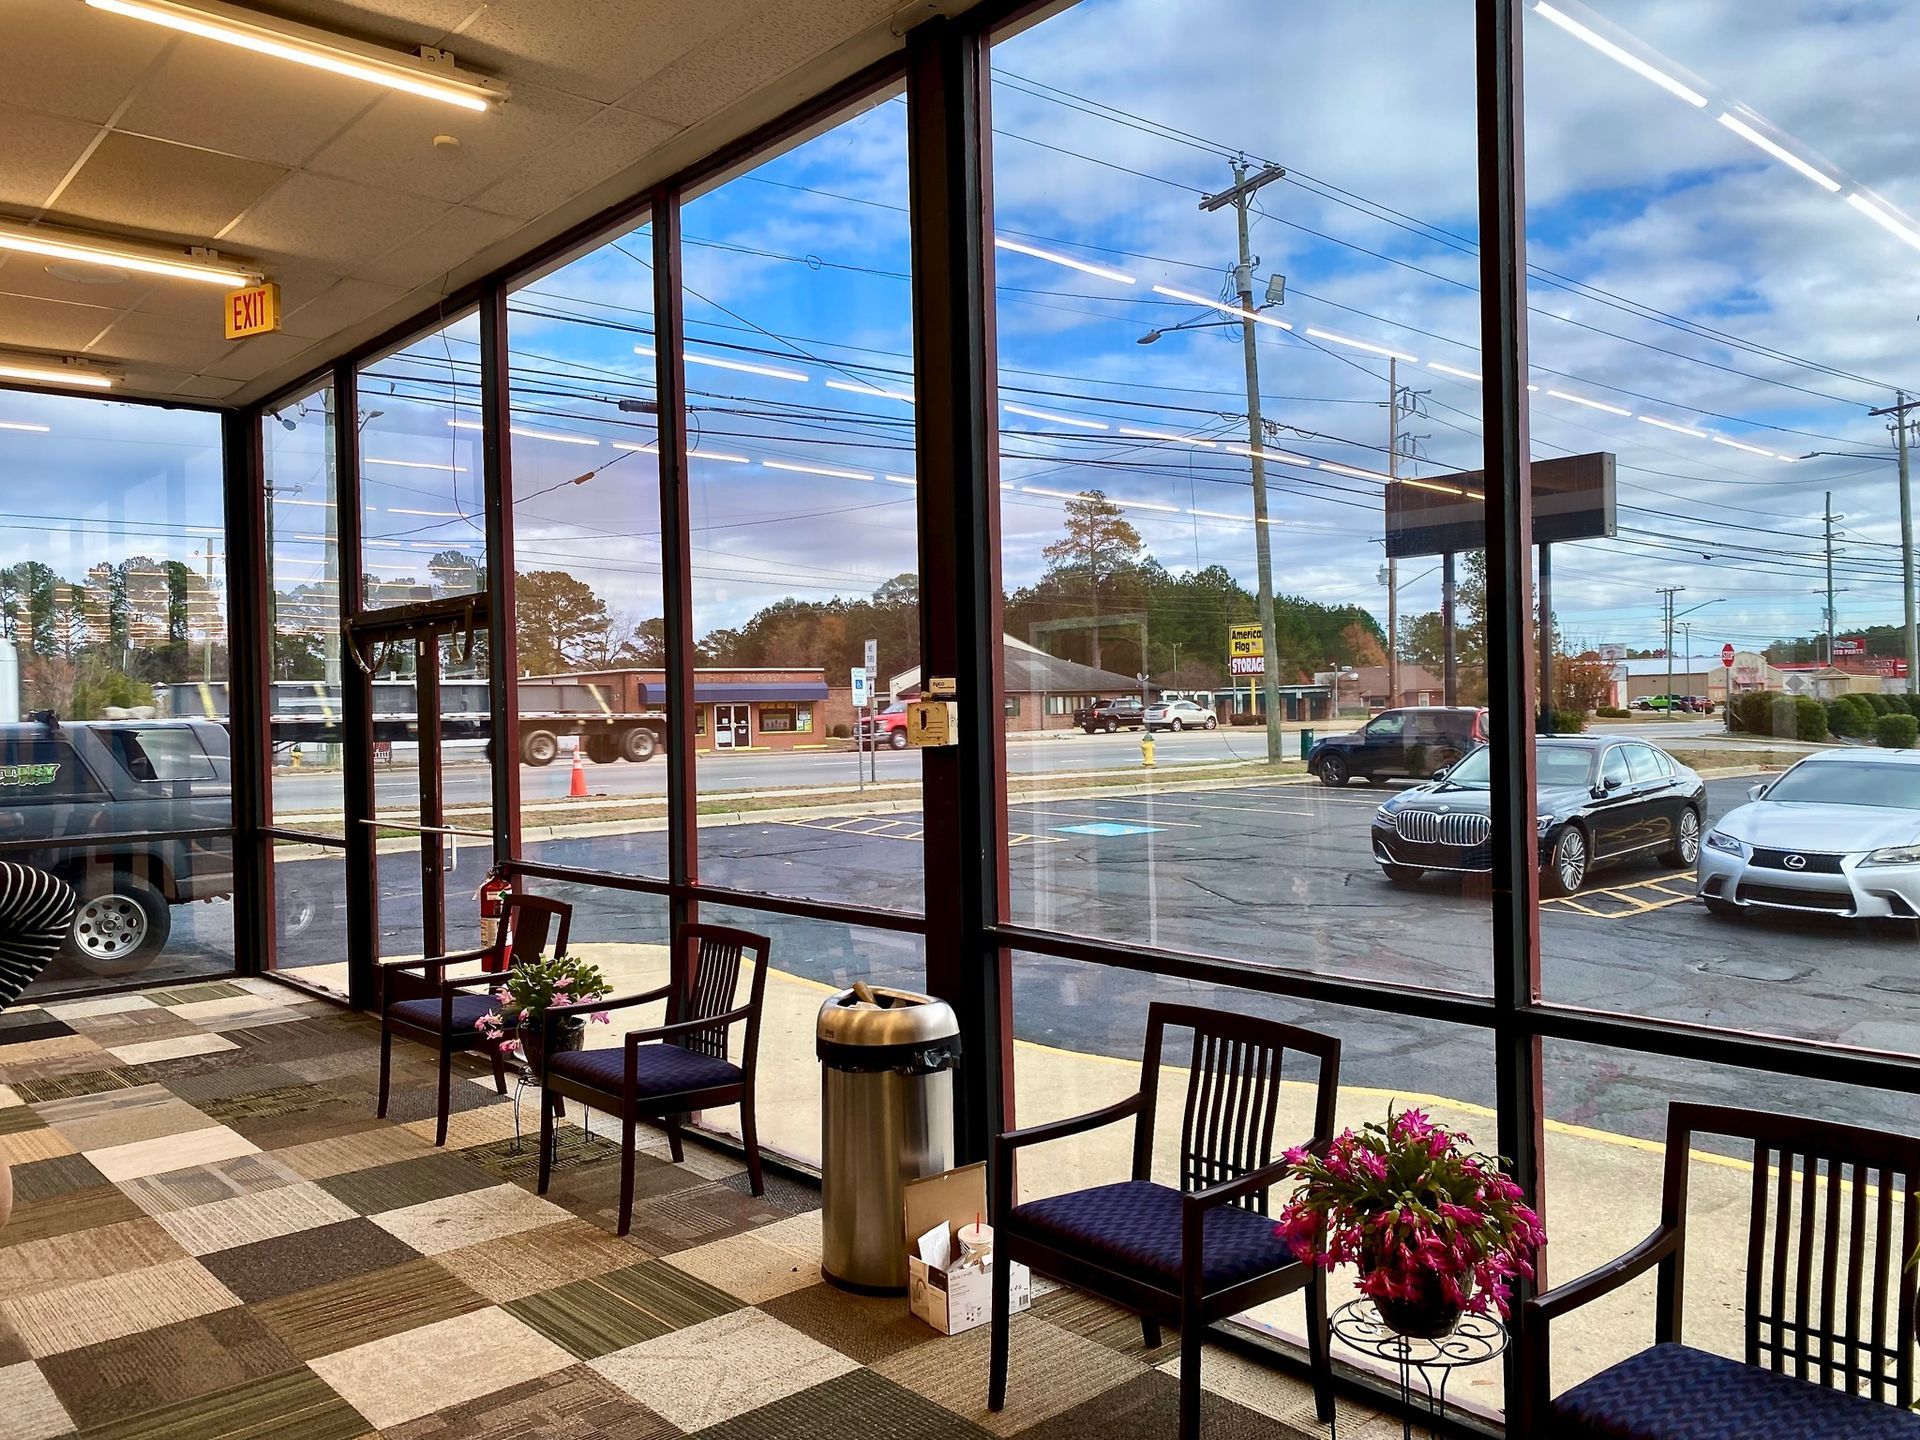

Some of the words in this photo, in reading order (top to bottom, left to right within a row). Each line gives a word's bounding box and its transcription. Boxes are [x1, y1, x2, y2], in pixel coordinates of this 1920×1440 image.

[233, 290, 266, 331] EXIT
[1232, 628, 1263, 640] America
[1235, 642, 1250, 652] Flag
[1722, 650, 1734, 660] STOP
[1232, 657, 1264, 673] STORAGE
